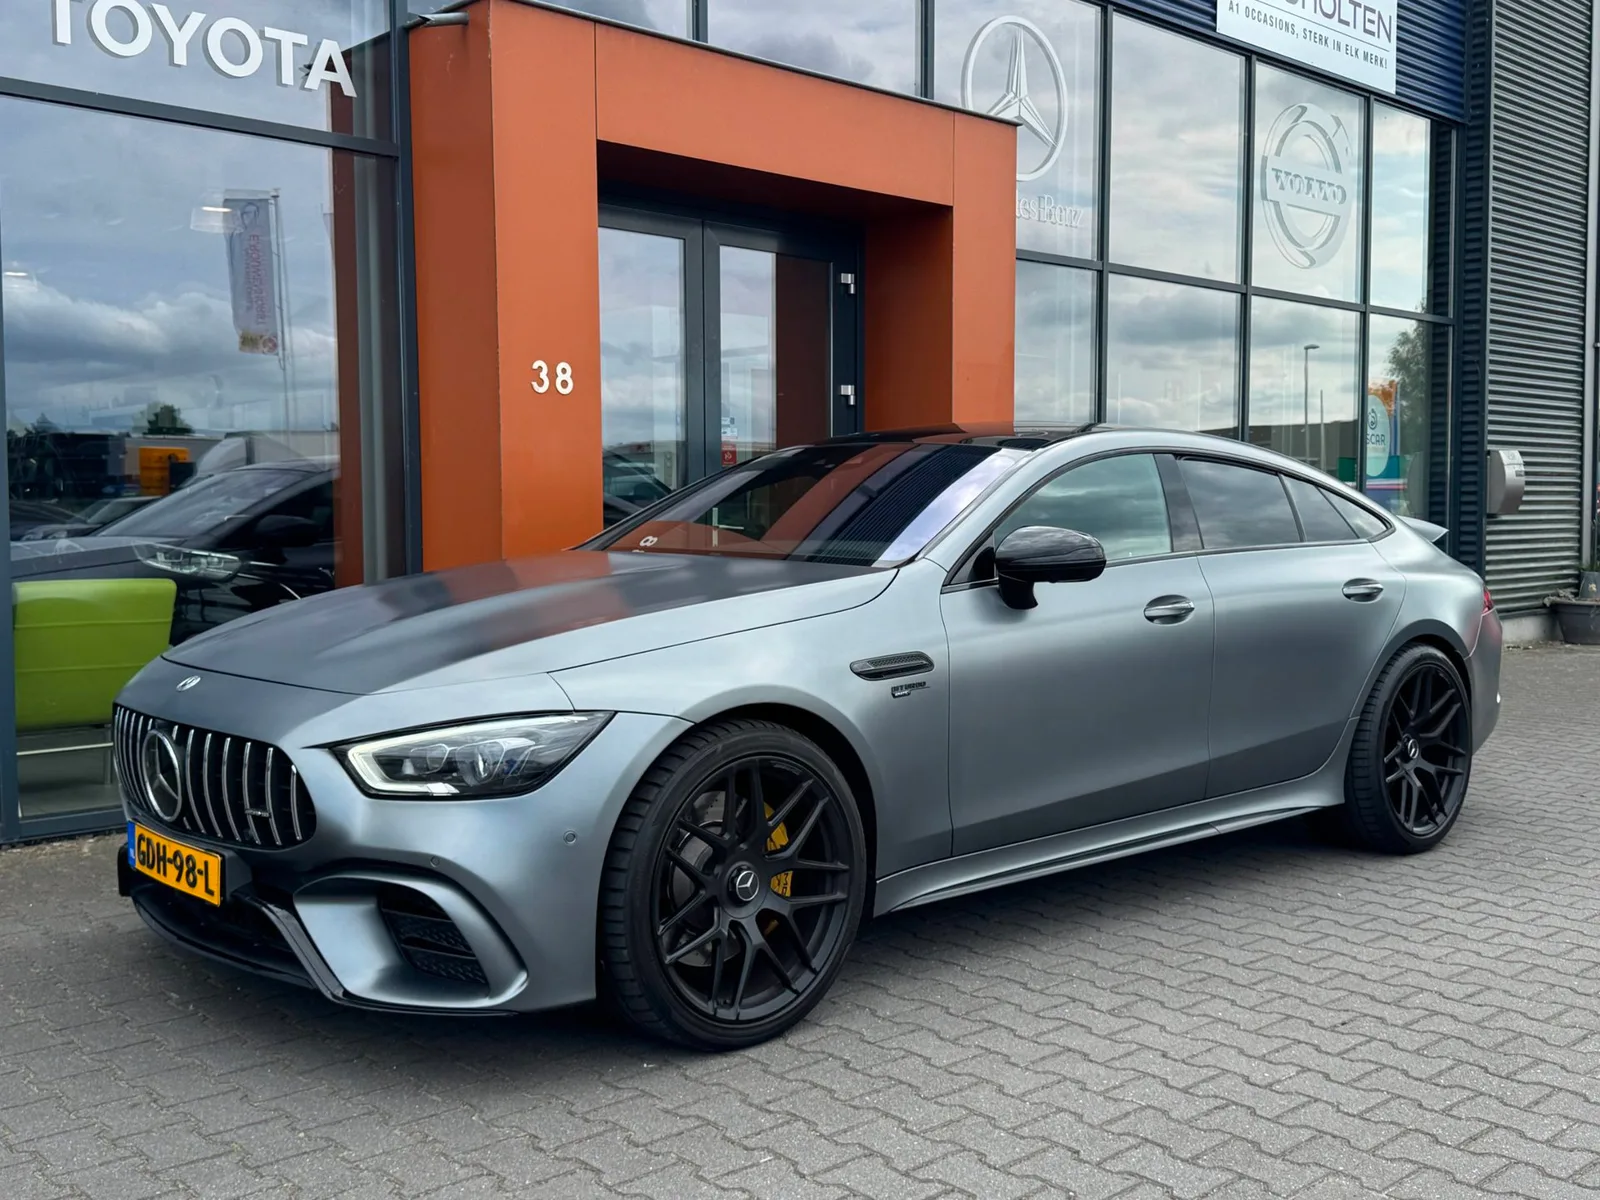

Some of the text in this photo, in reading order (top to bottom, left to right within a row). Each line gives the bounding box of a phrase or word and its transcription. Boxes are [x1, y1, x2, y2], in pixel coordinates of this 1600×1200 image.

[52, 0, 358, 98] TOYOTA
[1228, 0, 1388, 69] A1 OCCASIONS, STERK IN ELK MERK!
[1271, 167, 1347, 205] VOLVO
[530, 359, 574, 395] 38
[137, 833, 215, 896] GDH-98-L
